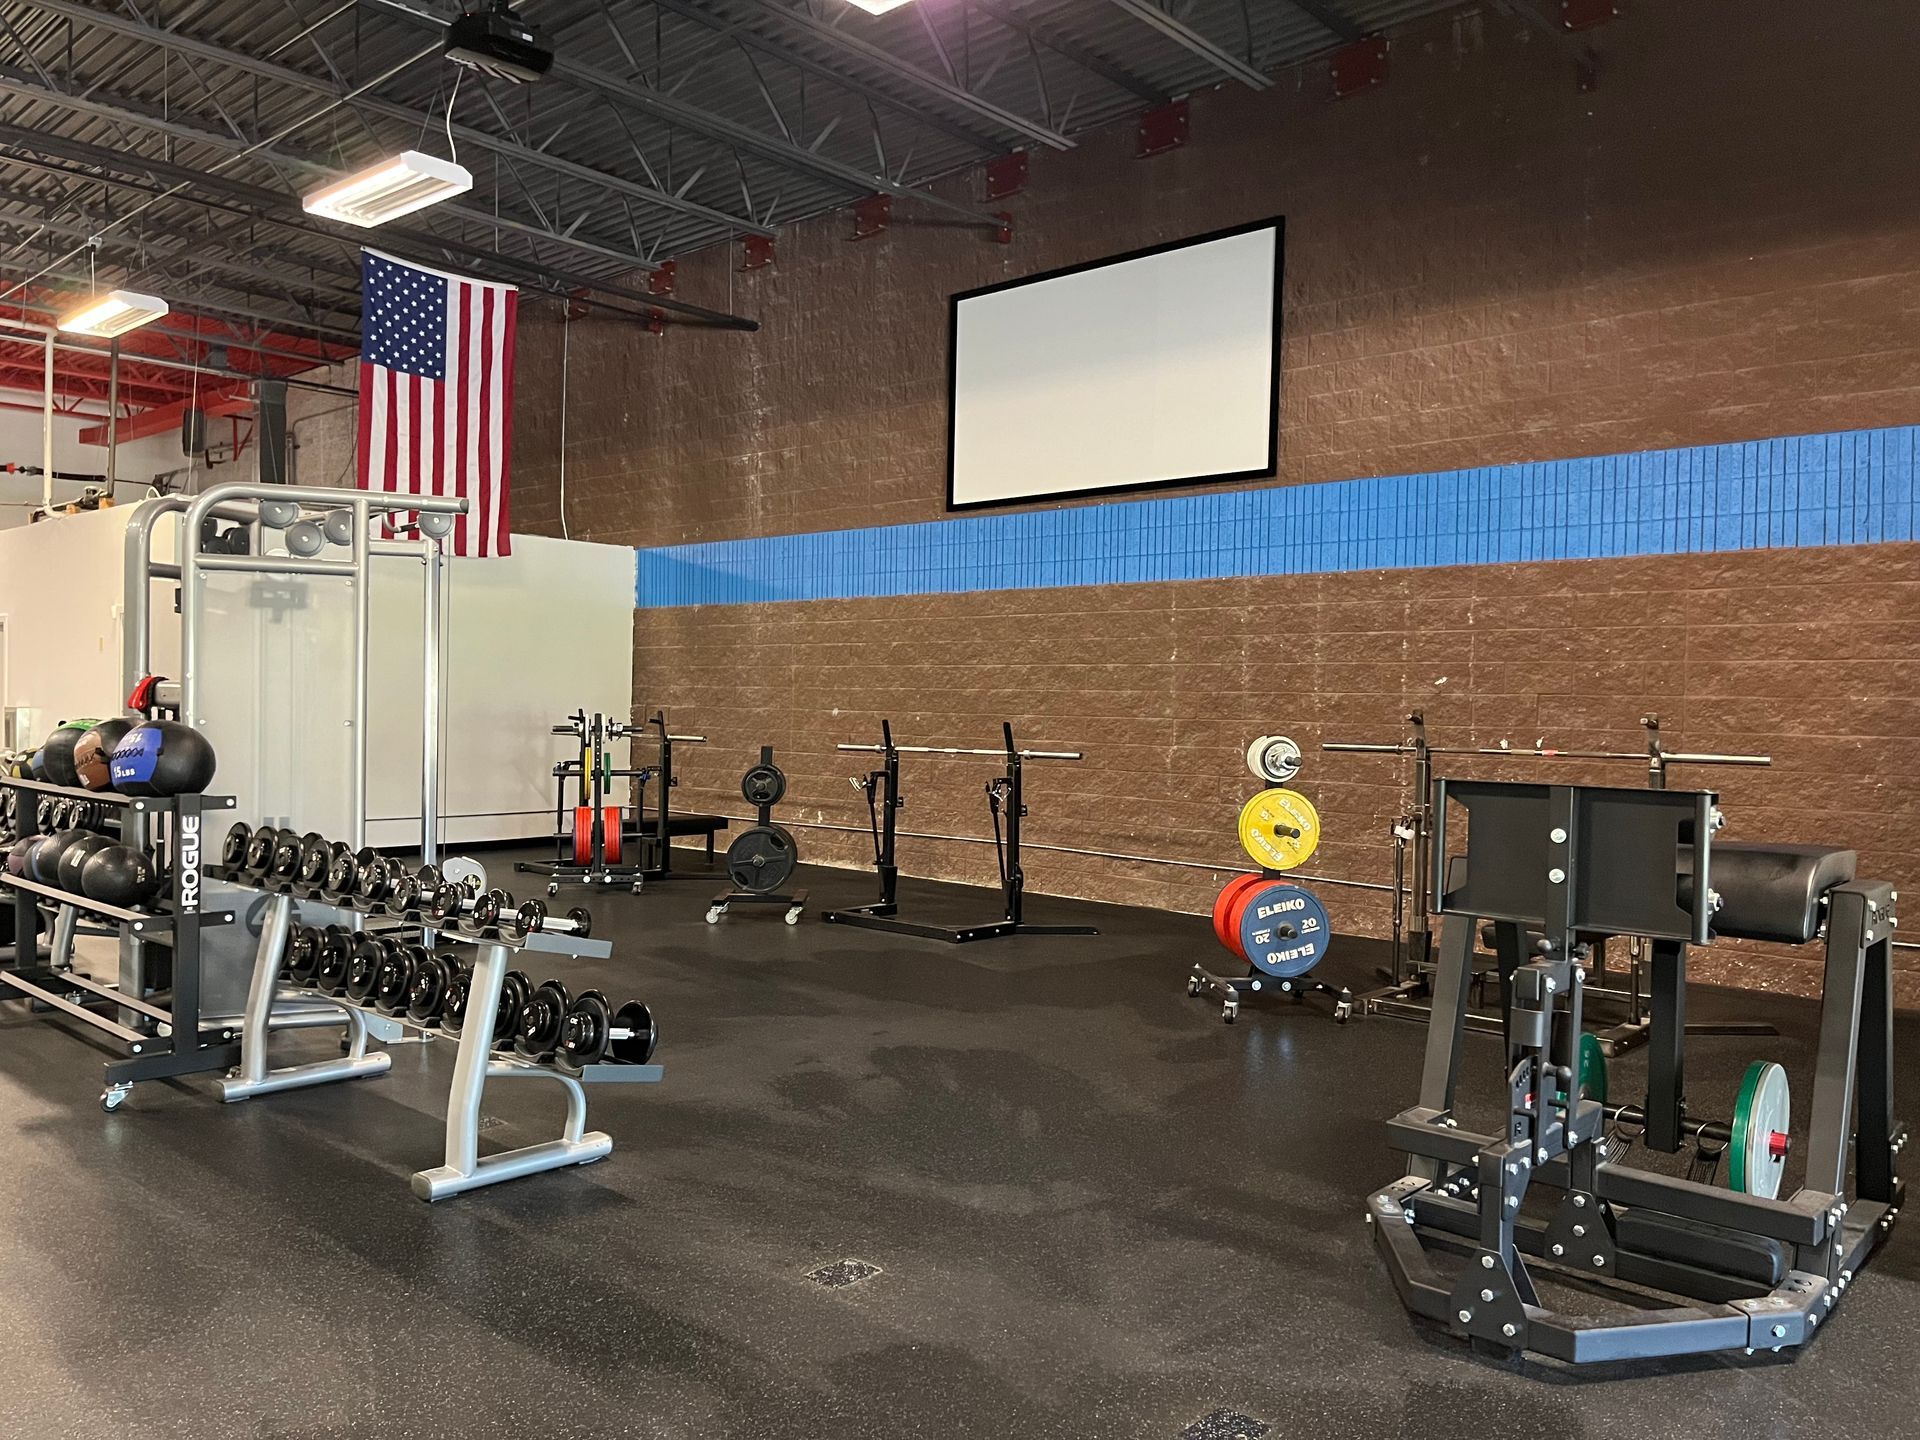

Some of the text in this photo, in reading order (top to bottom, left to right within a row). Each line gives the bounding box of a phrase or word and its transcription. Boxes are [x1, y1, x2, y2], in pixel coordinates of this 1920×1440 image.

[113, 765, 136, 779] 15 LBS
[1279, 798, 1311, 831] ELEIKO
[1251, 828, 1283, 862] ELEIKO
[181, 815, 199, 906] ROGUE
[1257, 898, 1305, 919] ELEIKO
[1301, 917, 1317, 929] 20
[1255, 933, 1270, 944] 20
[1266, 942, 1315, 964] ELEIKO
